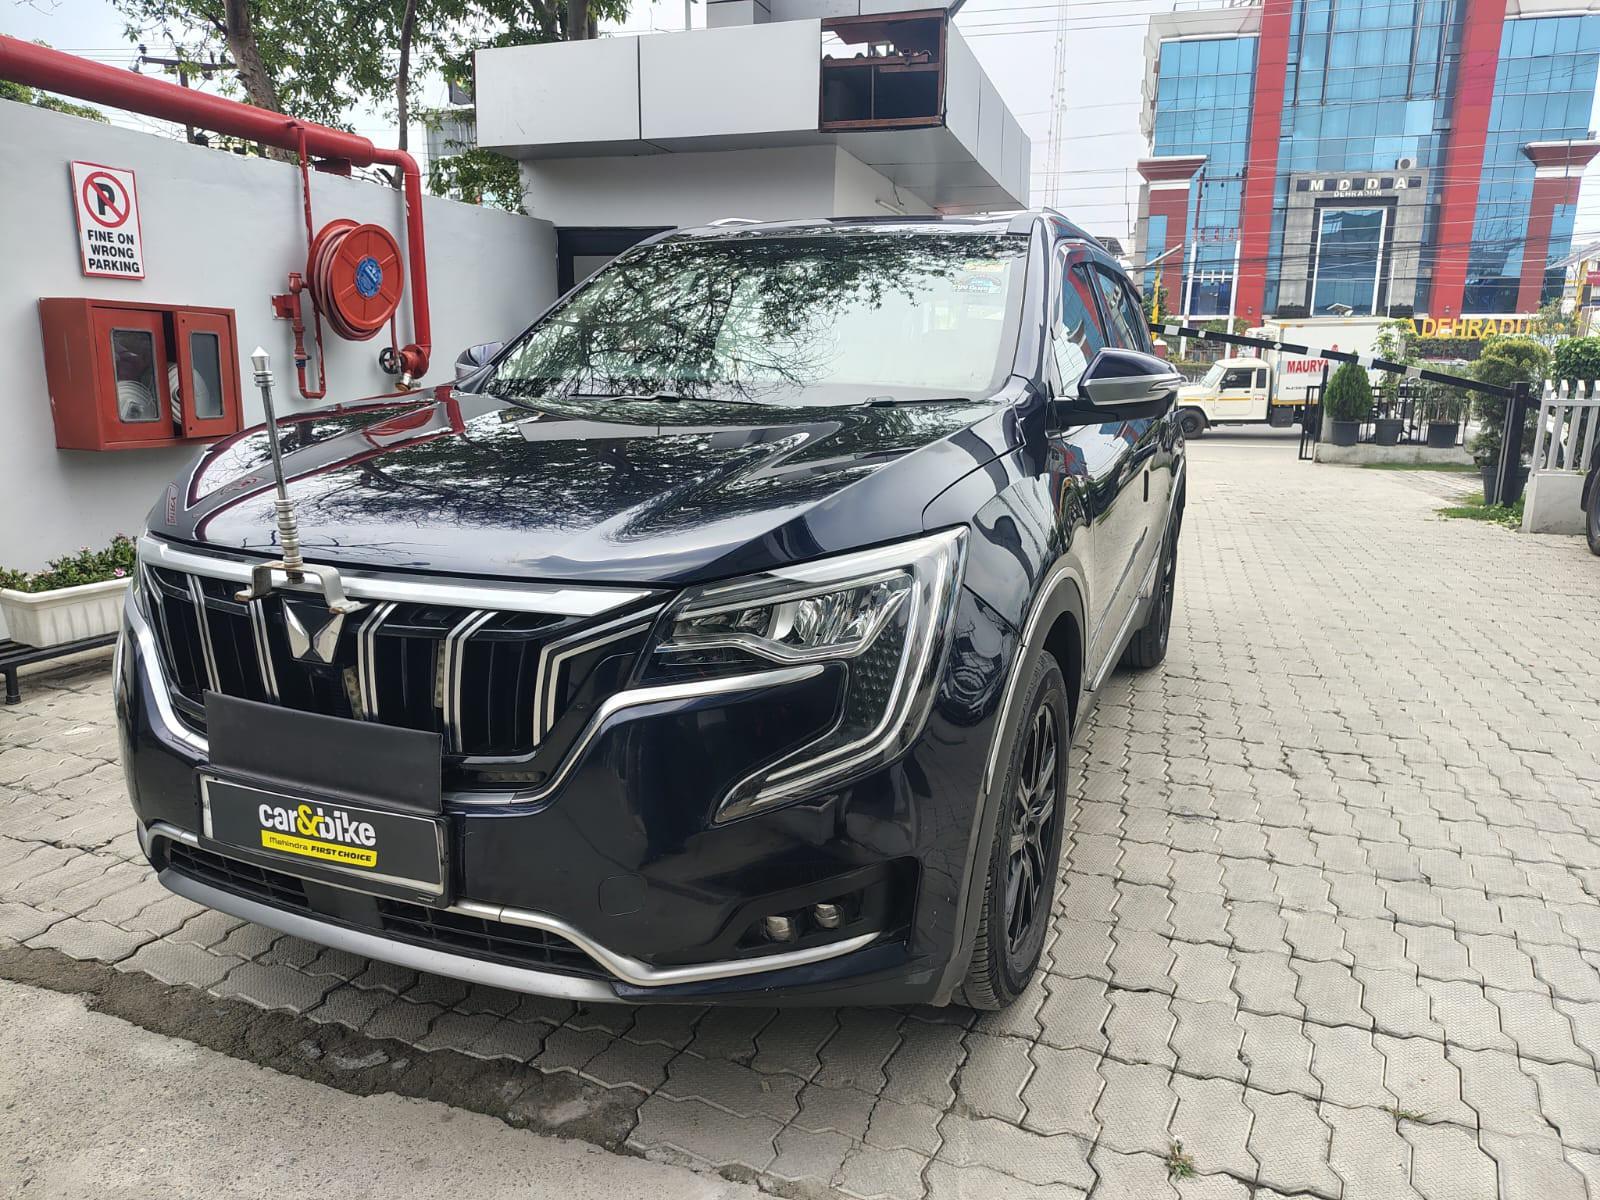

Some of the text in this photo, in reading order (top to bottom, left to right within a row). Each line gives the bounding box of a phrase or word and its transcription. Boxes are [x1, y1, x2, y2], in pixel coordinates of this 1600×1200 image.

[1333, 190, 1382, 198] DEHRADUN
[87, 229, 135, 245] FINE ON
[90, 244, 135, 258] WRONG
[88, 258, 140, 273] PARKING
[258, 804, 377, 847] car&bike
[311, 845, 337, 856] FIRST
[338, 850, 372, 862] CHOICE
